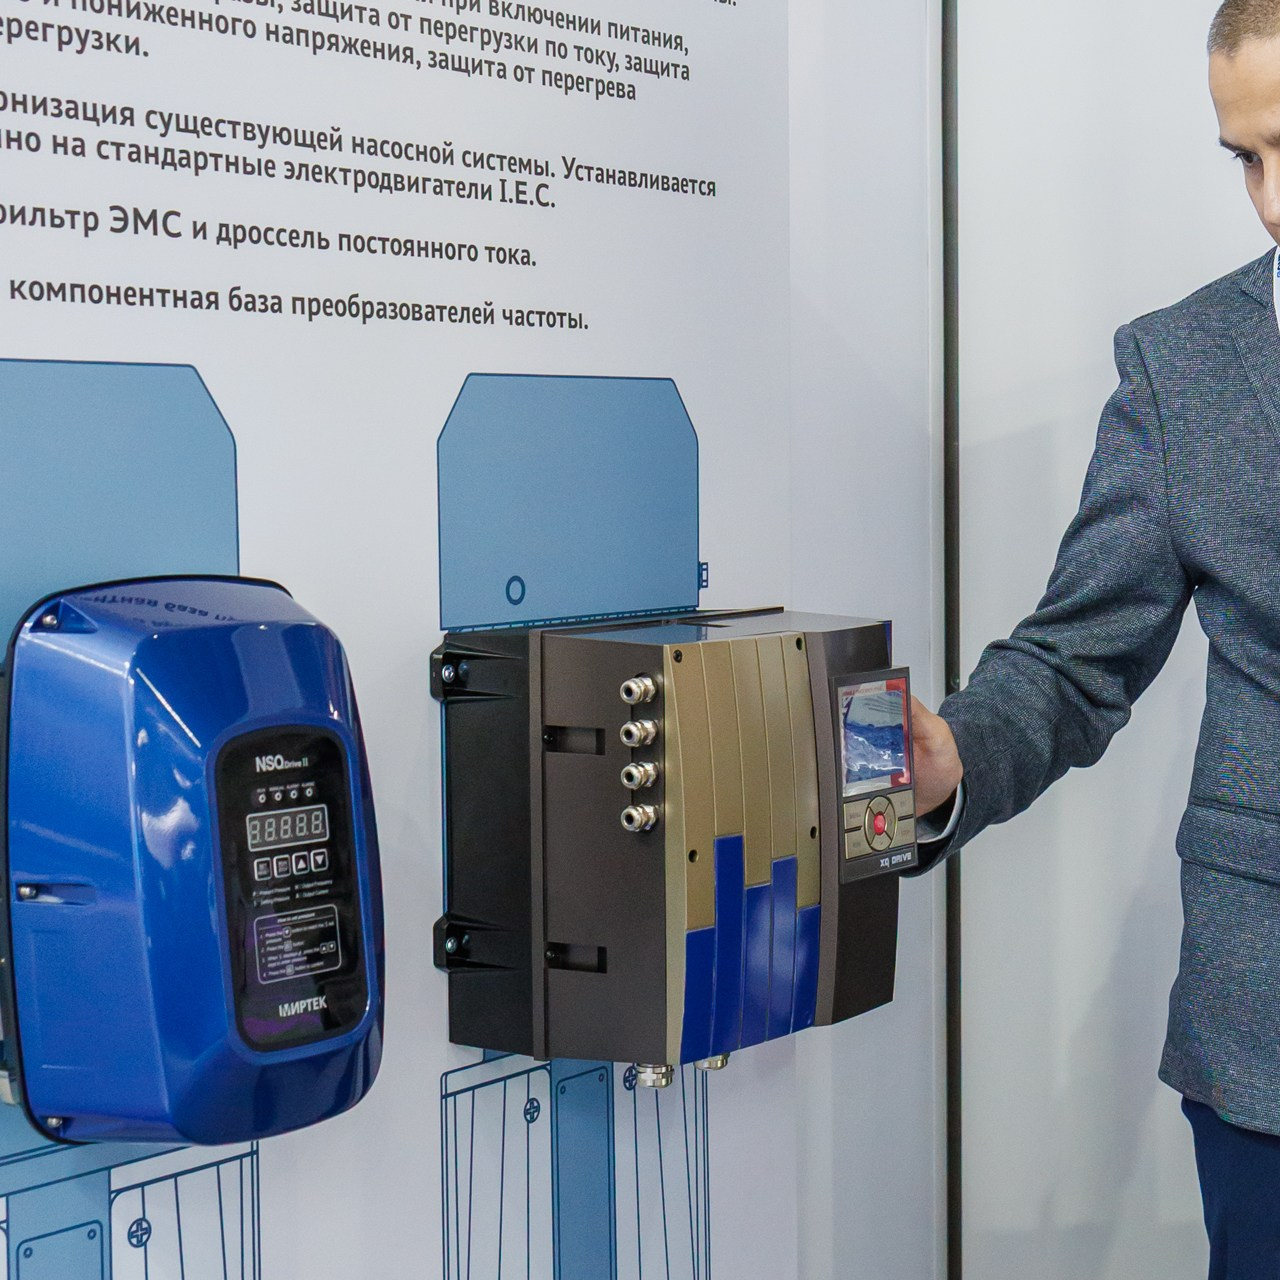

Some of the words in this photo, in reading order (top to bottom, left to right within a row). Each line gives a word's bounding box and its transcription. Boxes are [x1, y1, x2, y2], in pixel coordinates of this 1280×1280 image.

[0, 16, 149, 58] регрузки.
[265, 22, 422, 71] напряжения,
[427, 50, 508, 81] защита
[513, 64, 536, 84] от
[541, 69, 637, 101] перегрева
[387, 11, 413, 32] от
[419, 16, 539, 55] перегрузки
[545, 39, 568, 60] по
[572, 44, 620, 74] току,
[624, 54, 690, 82] защита
[607, 21, 689, 57] питания,
[0, 128, 42, 153] но
[51, 134, 87, 158] на
[96, 139, 277, 179] стандартные
[283, 160, 493, 202] электродвигатели
[498, 178, 556, 209] I.E.C.
[144, 109, 343, 153] существующей
[351, 135, 455, 166] насосной
[461, 149, 556, 179] системы.
[560, 155, 716, 198] Устанавливается
[108, 204, 183, 239] ЭМС
[192, 220, 208, 241] и
[215, 222, 331, 251] дроссель
[338, 233, 479, 263] постоянного
[483, 245, 537, 267] тока.
[9, 279, 220, 311] компонентная
[228, 285, 283, 314] база
[291, 292, 495, 326] преобразователей
[501, 308, 589, 330] частоты.
[255, 753, 284, 773] NSQ
